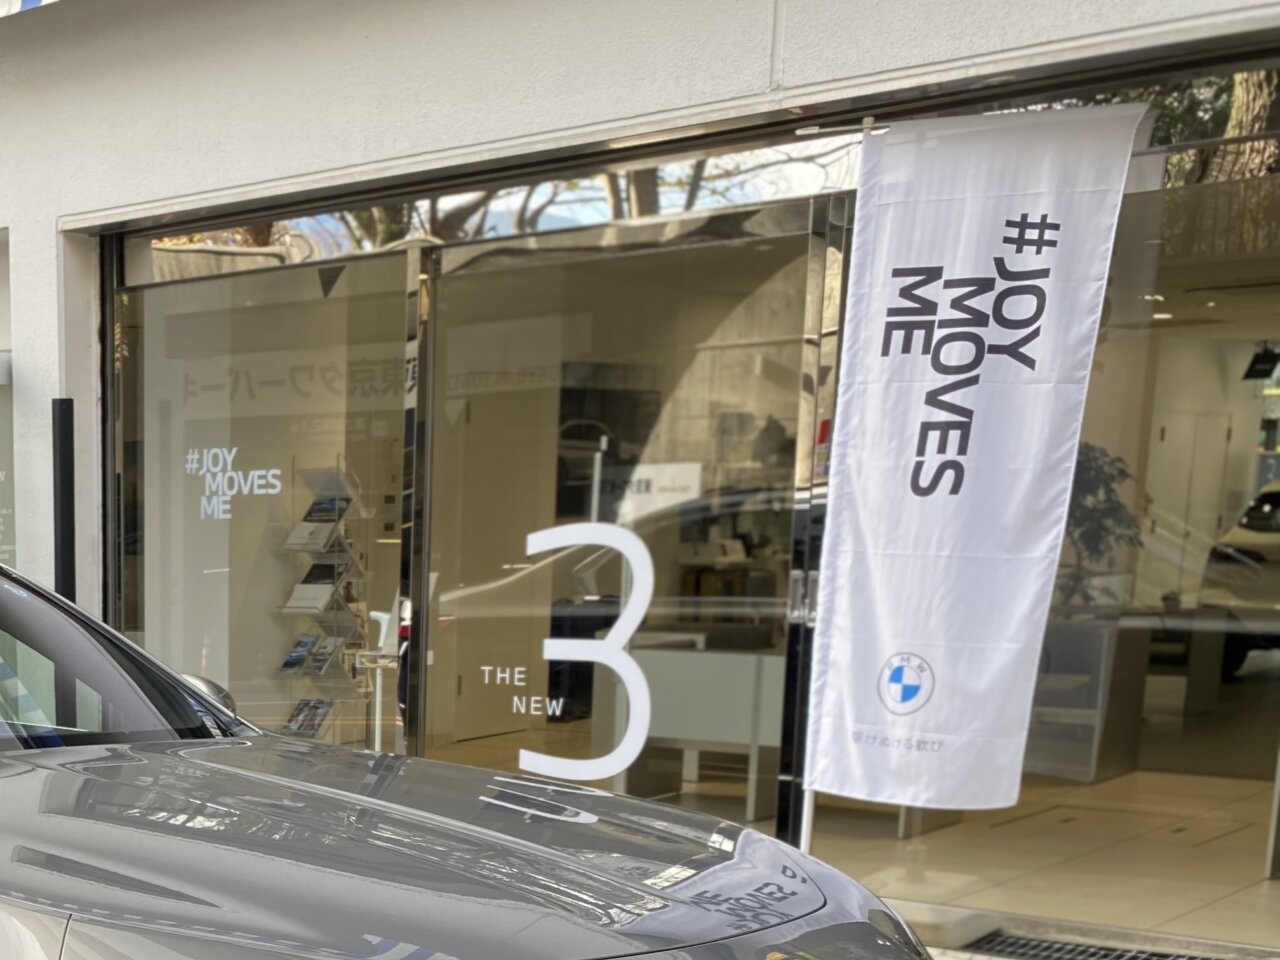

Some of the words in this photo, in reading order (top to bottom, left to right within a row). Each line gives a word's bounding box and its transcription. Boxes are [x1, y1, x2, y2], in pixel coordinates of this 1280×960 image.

[986, 213, 1061, 371] #JOY
[880, 265, 944, 358] ME
[909, 276, 997, 498] MOVES
[185, 447, 238, 476] #JOY
[205, 469, 282, 496] MOVES
[200, 496, 232, 519] ME
[518, 522, 655, 781] 3
[481, 666, 527, 686] THE
[512, 696, 564, 717] NEW
